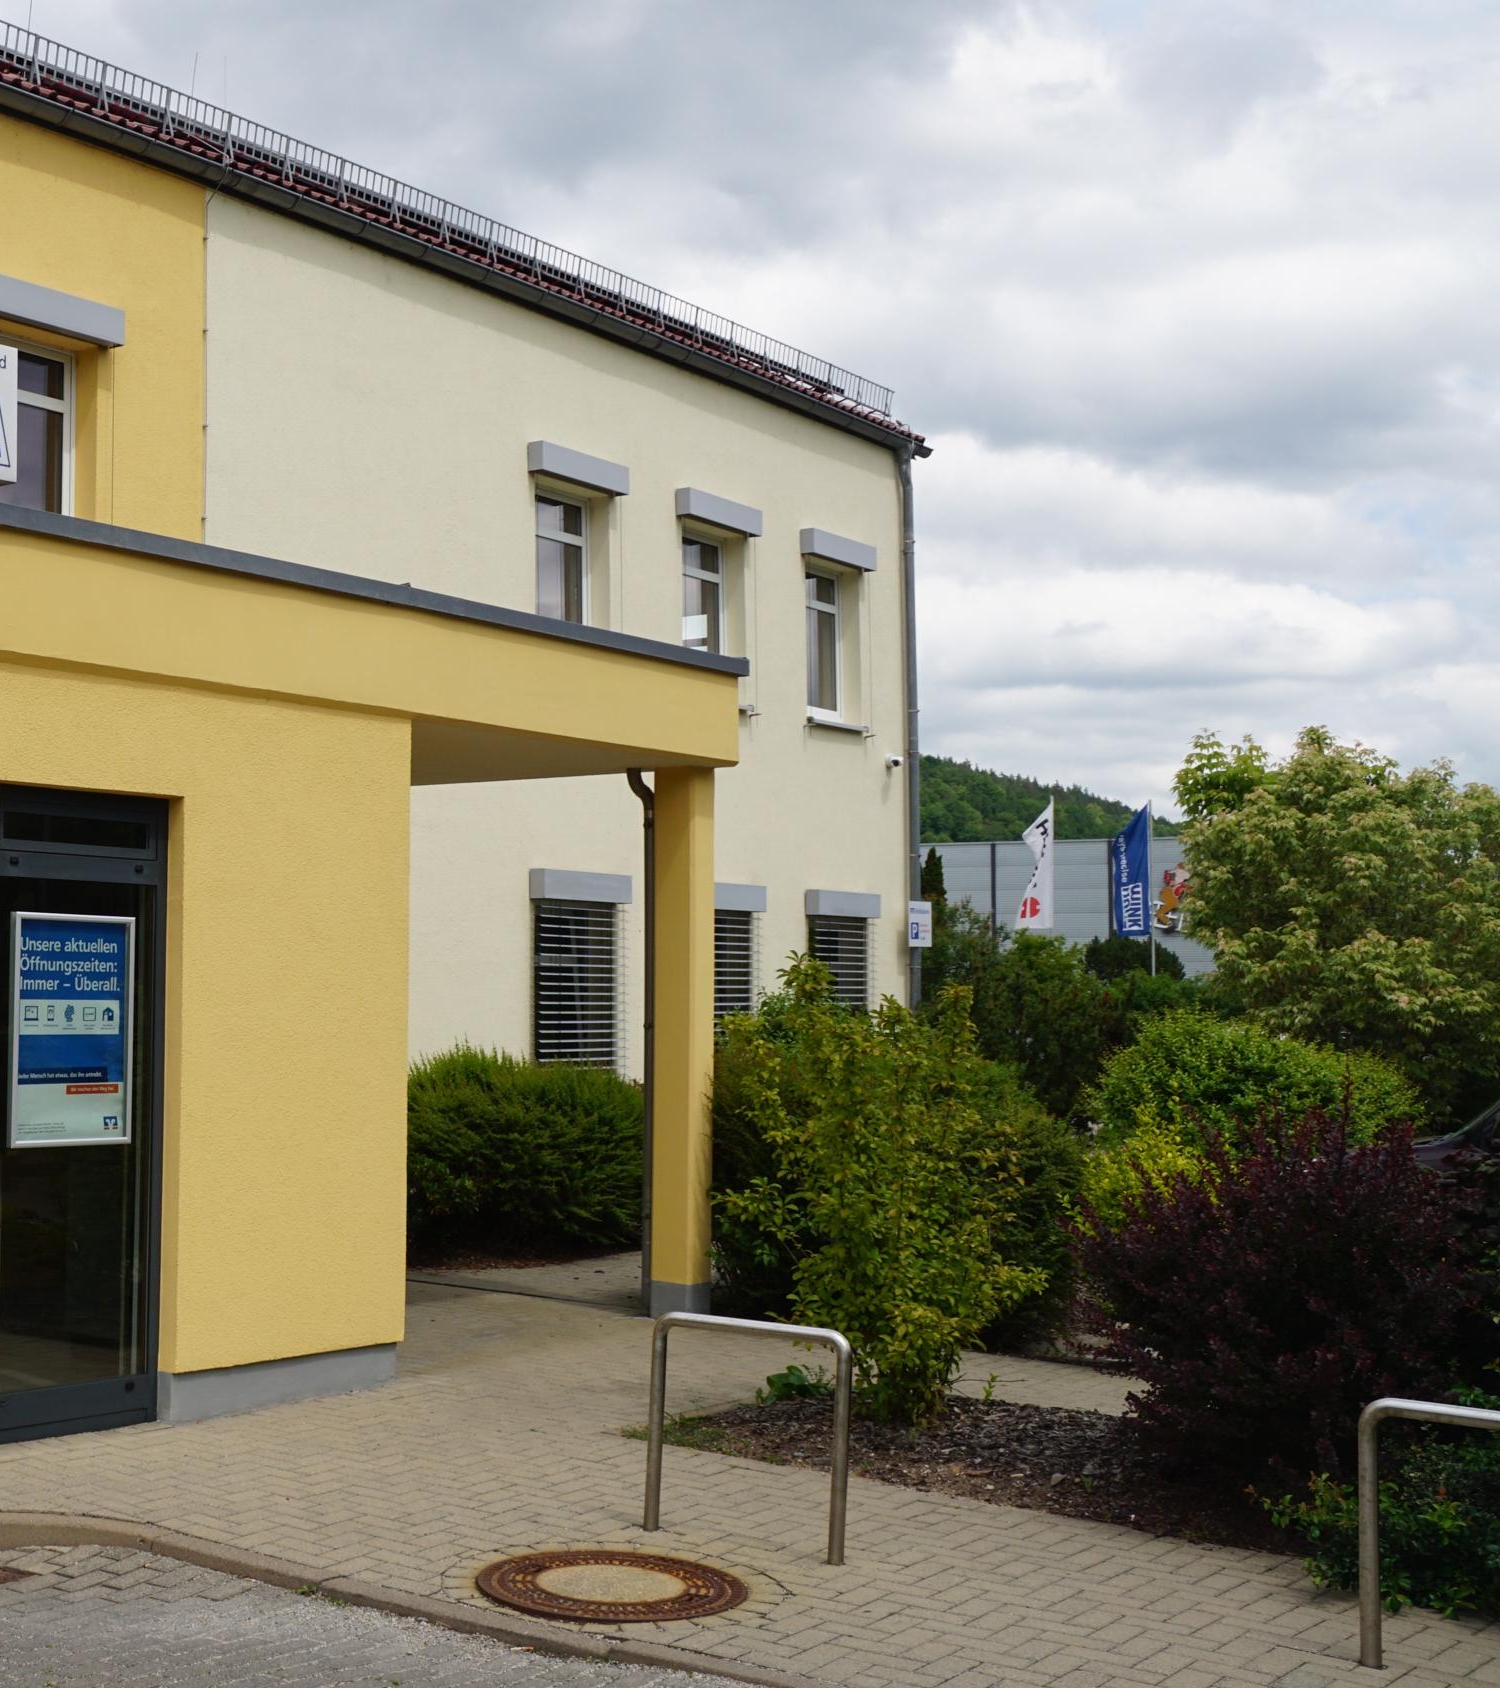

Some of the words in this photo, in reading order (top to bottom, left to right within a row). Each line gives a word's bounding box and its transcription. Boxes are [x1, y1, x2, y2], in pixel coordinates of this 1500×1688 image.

[20, 936, 61, 952] Unsere
[64, 937, 118, 953] aktuellen
[20, 953, 118, 975] Öffnungszeiten:
[20, 976, 59, 990] Immer
[74, 974, 120, 991] Überall.
